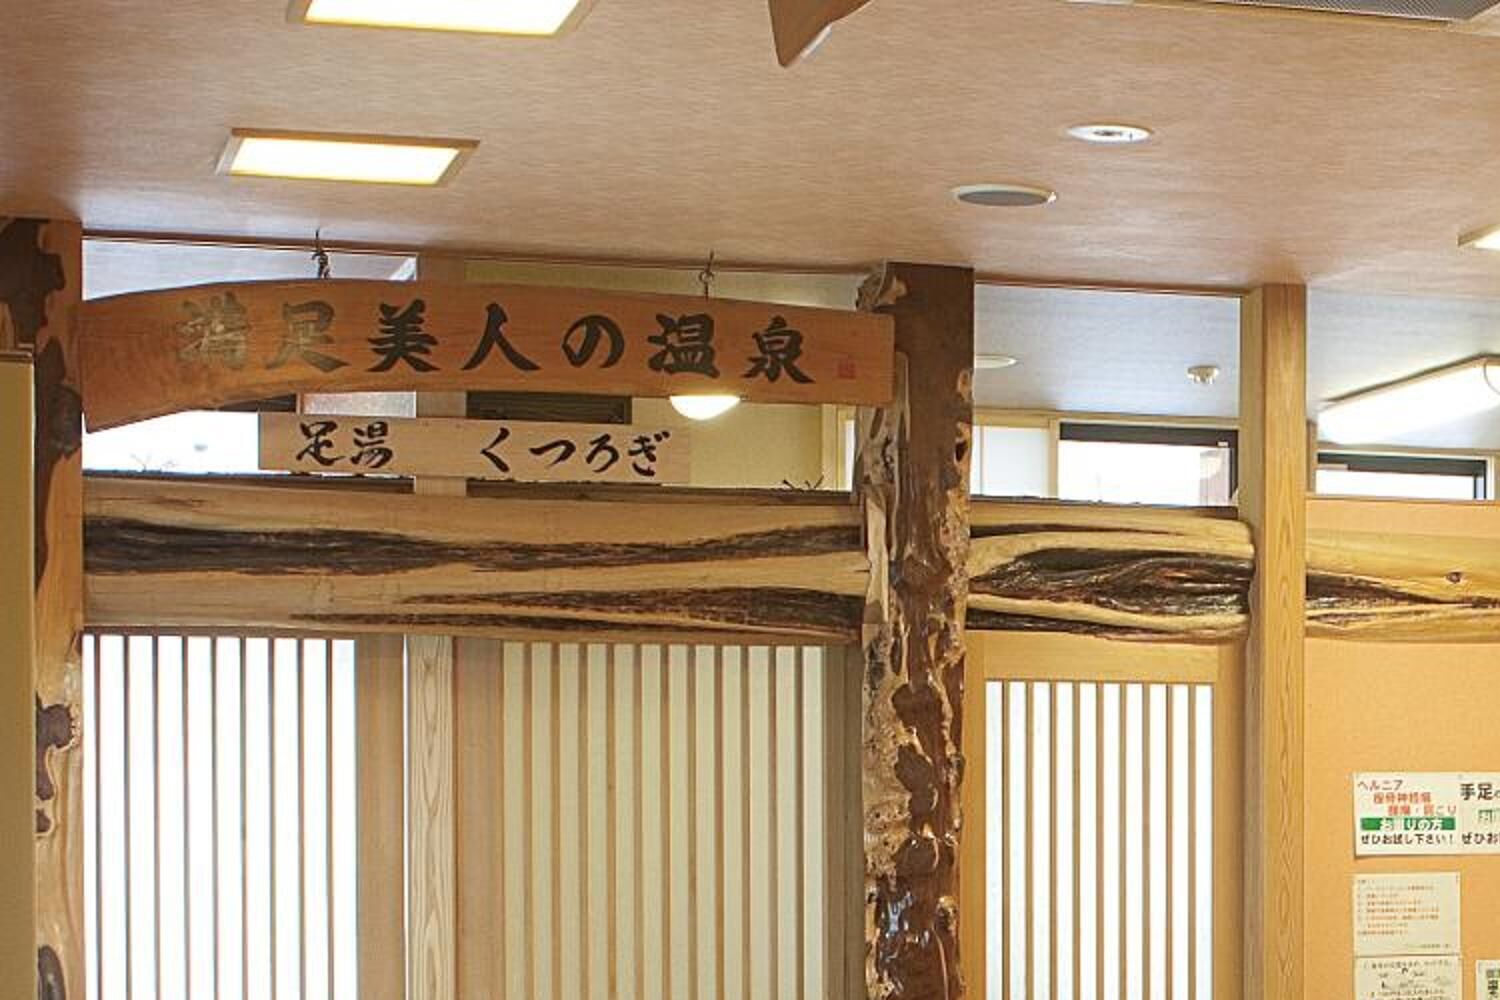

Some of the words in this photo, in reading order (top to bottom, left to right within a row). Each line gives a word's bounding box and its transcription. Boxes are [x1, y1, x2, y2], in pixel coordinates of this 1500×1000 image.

[296, 421, 394, 468] 足湯
[480, 427, 671, 477] くつろぎ
